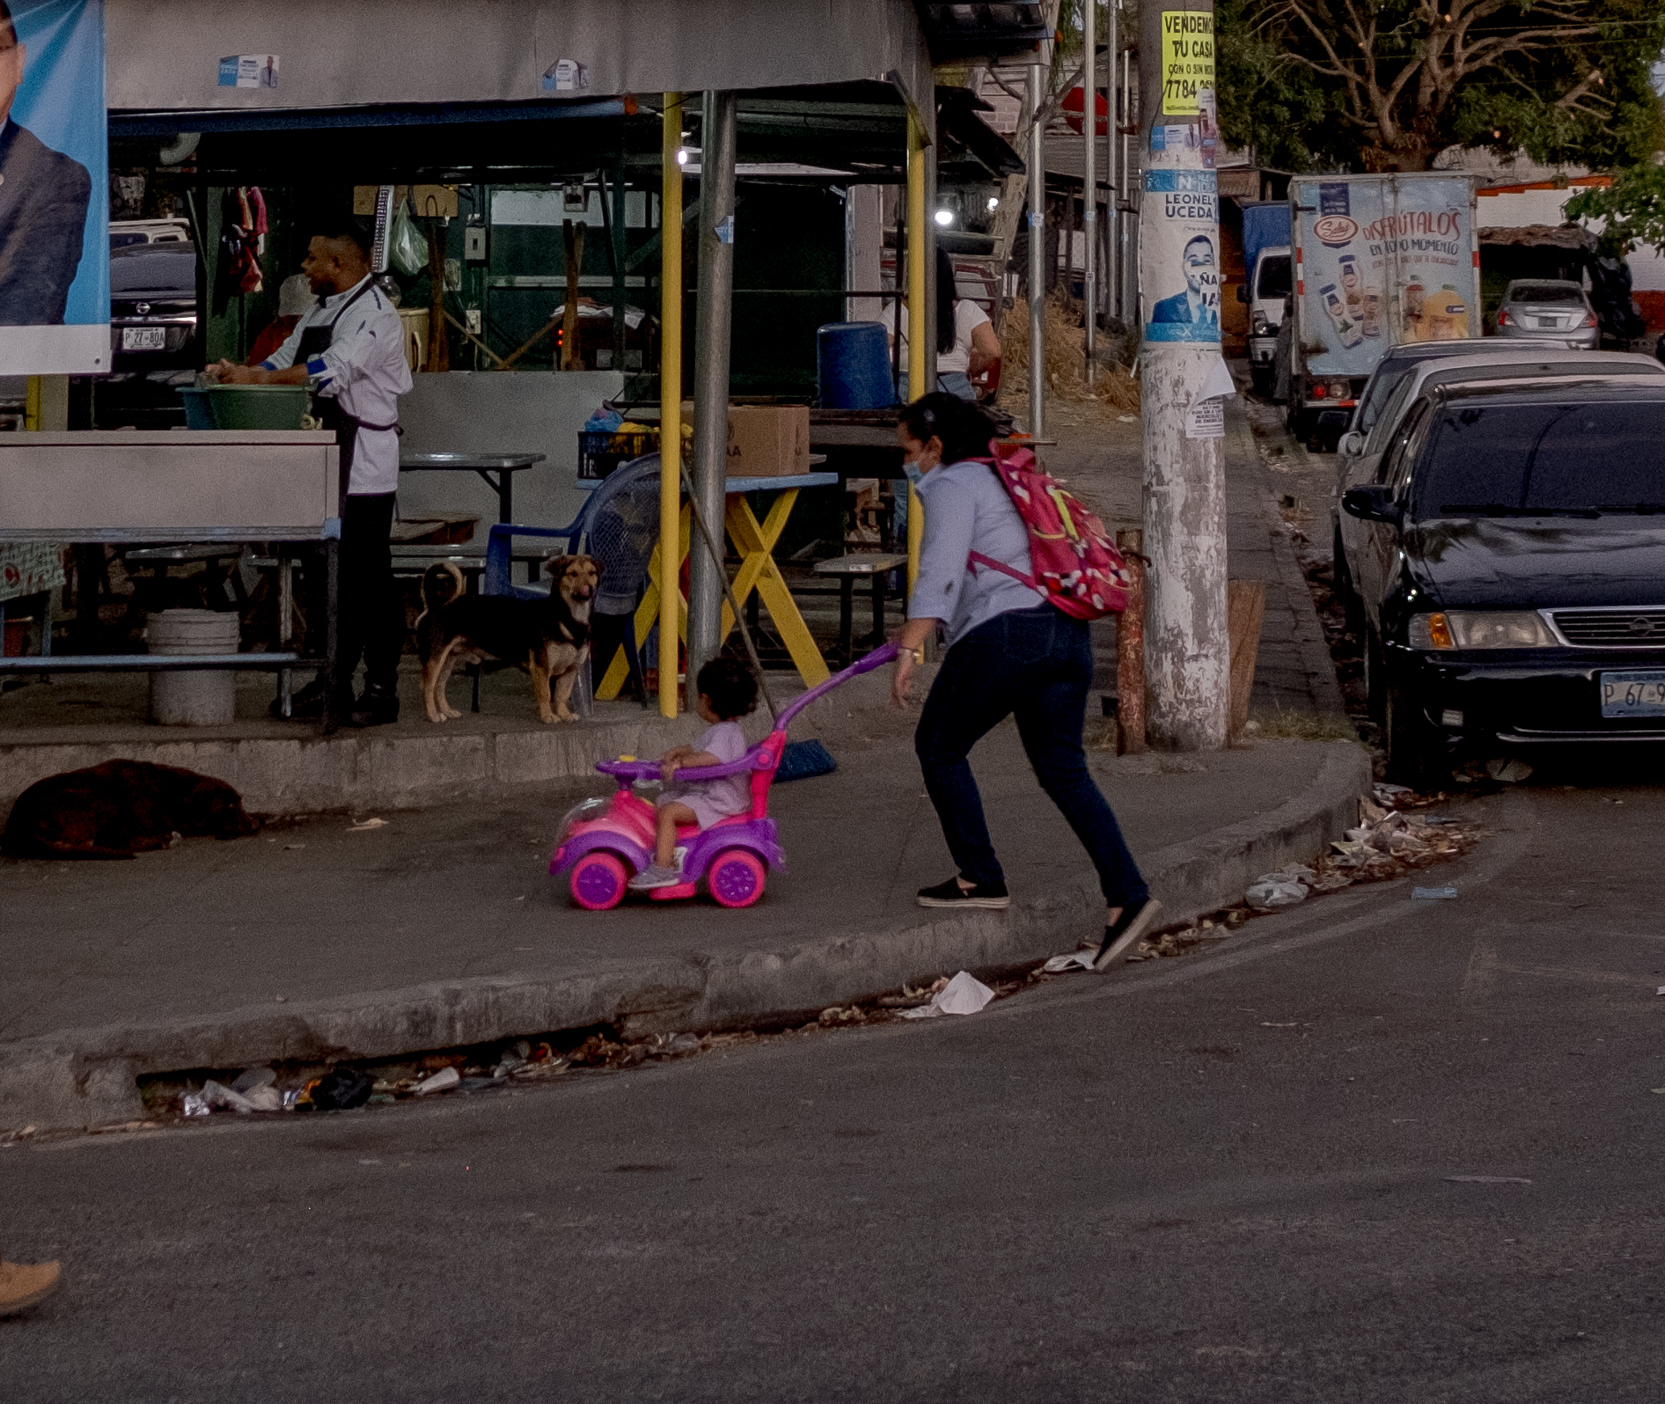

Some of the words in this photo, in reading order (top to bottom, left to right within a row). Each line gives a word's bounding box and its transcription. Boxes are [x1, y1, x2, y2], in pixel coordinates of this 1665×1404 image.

[1172, 40, 1188, 58] TU
[1165, 193, 1213, 205] LEONEL
[1165, 205, 1213, 218] UCEDA
